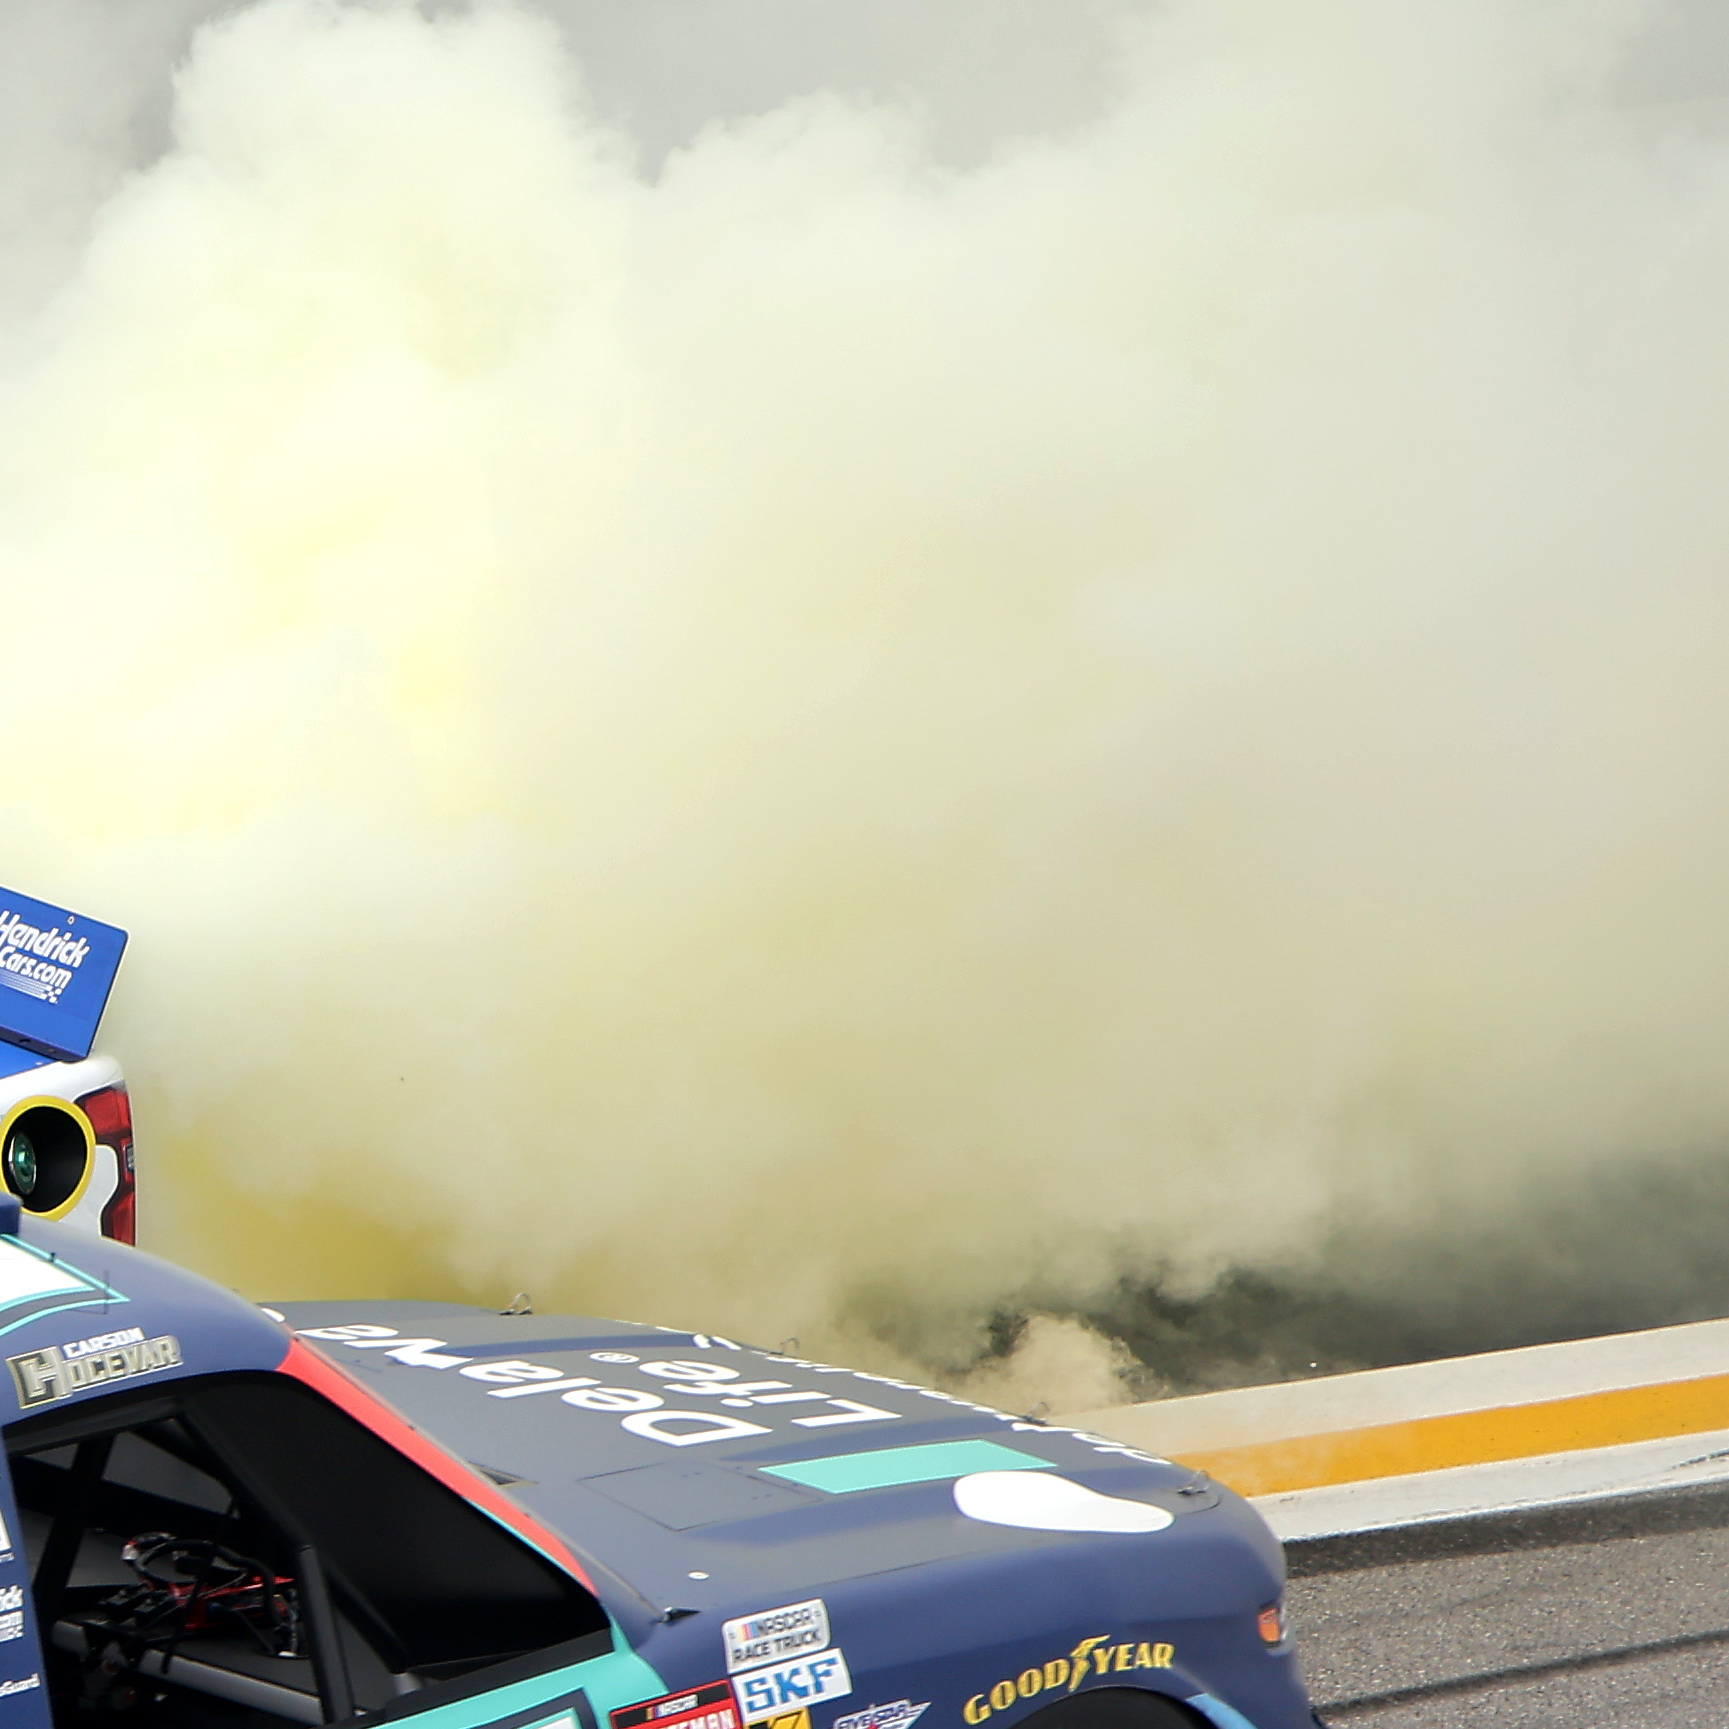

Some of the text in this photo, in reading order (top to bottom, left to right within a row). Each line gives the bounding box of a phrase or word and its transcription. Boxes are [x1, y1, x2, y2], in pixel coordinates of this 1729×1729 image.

[62, 1327, 144, 1358] CARSON
[18, 1334, 183, 1399] HOCEVAR
[758, 1607, 812, 1634] NASCAR
[733, 1629, 821, 1665] RACE TRUCK
[743, 1656, 838, 1713] SKF
[964, 1635, 1175, 1727] GOODYEAR
